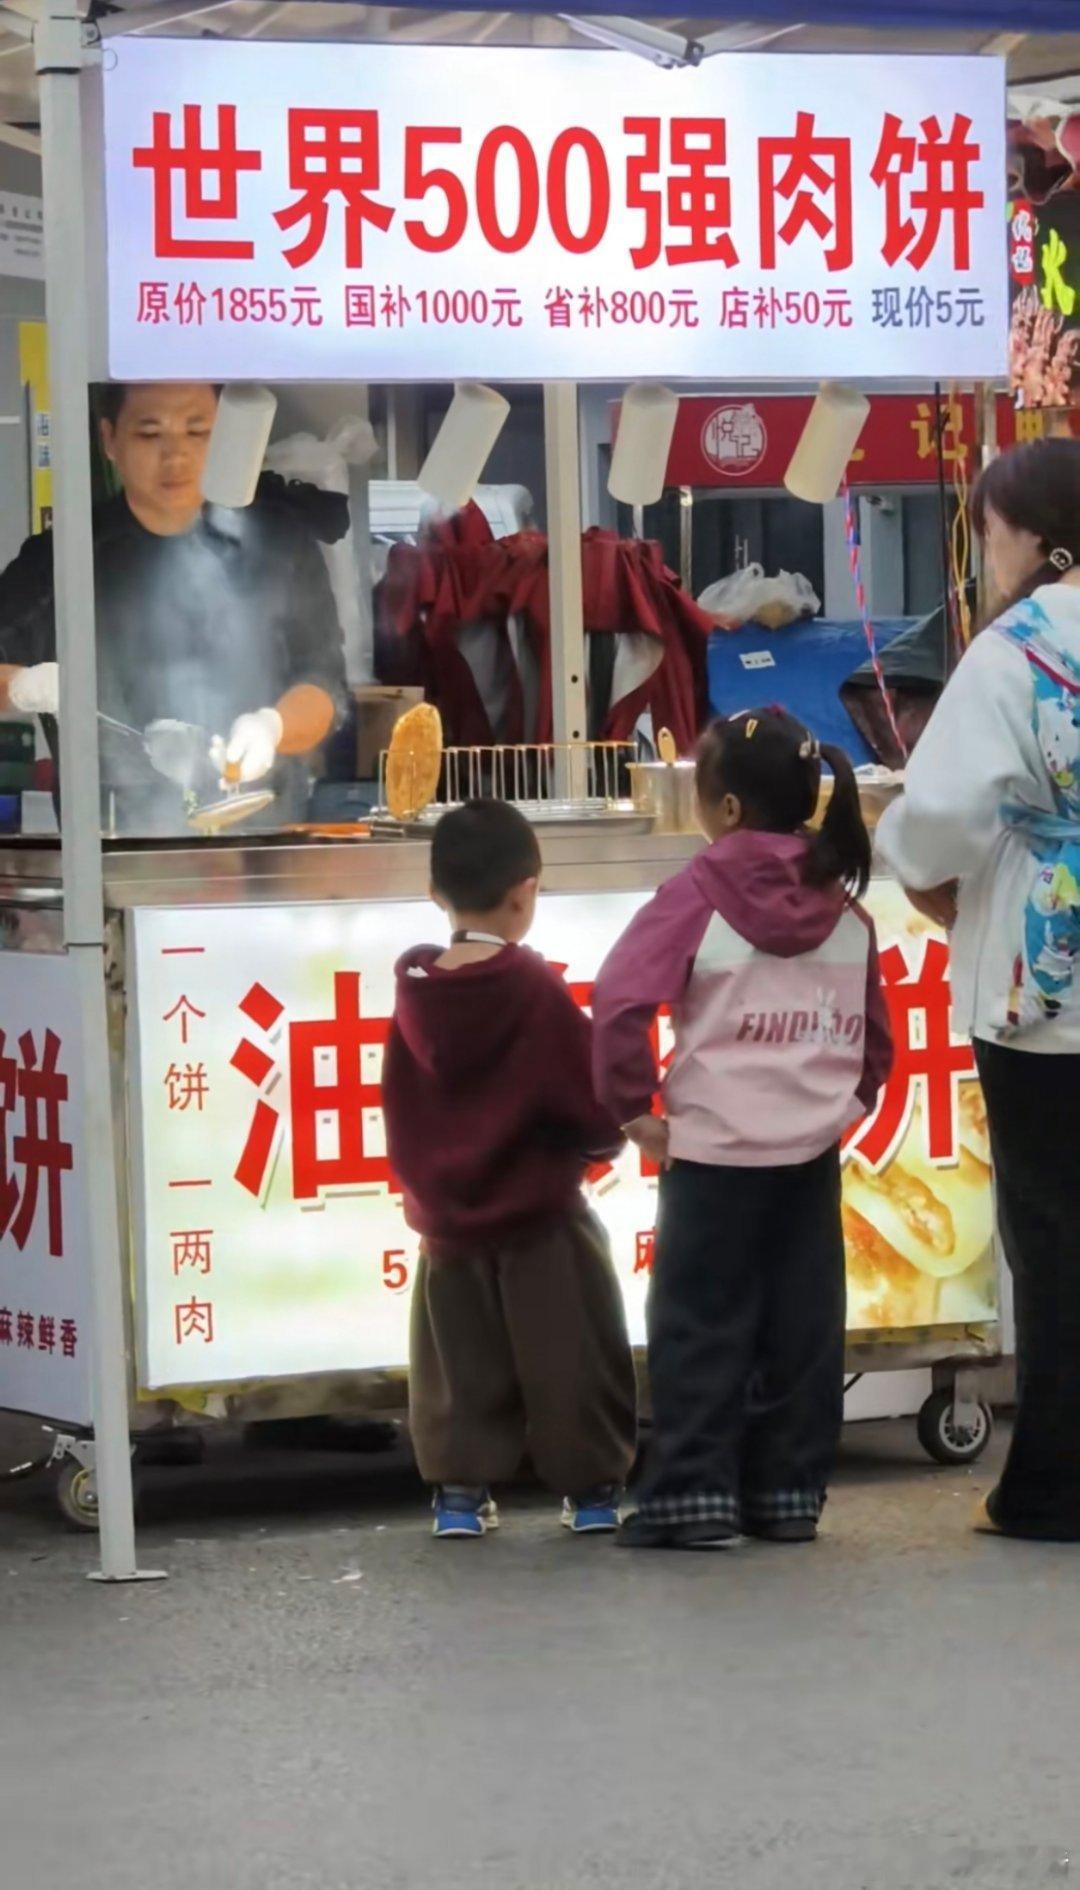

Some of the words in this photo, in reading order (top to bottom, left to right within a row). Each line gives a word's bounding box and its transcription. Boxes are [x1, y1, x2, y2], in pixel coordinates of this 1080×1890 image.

[132, 104, 985, 270] 世界500强肉饼
[136, 281, 323, 327] 原价1855元
[344, 284, 523, 328] 国补1000元
[544, 286, 699, 328] 省补800元
[720, 286, 853, 329] 店补50元
[871, 285, 985, 328] 现价5元
[162, 947, 209, 1111] 一个饼
[168, 1180, 213, 1344] 一两肉
